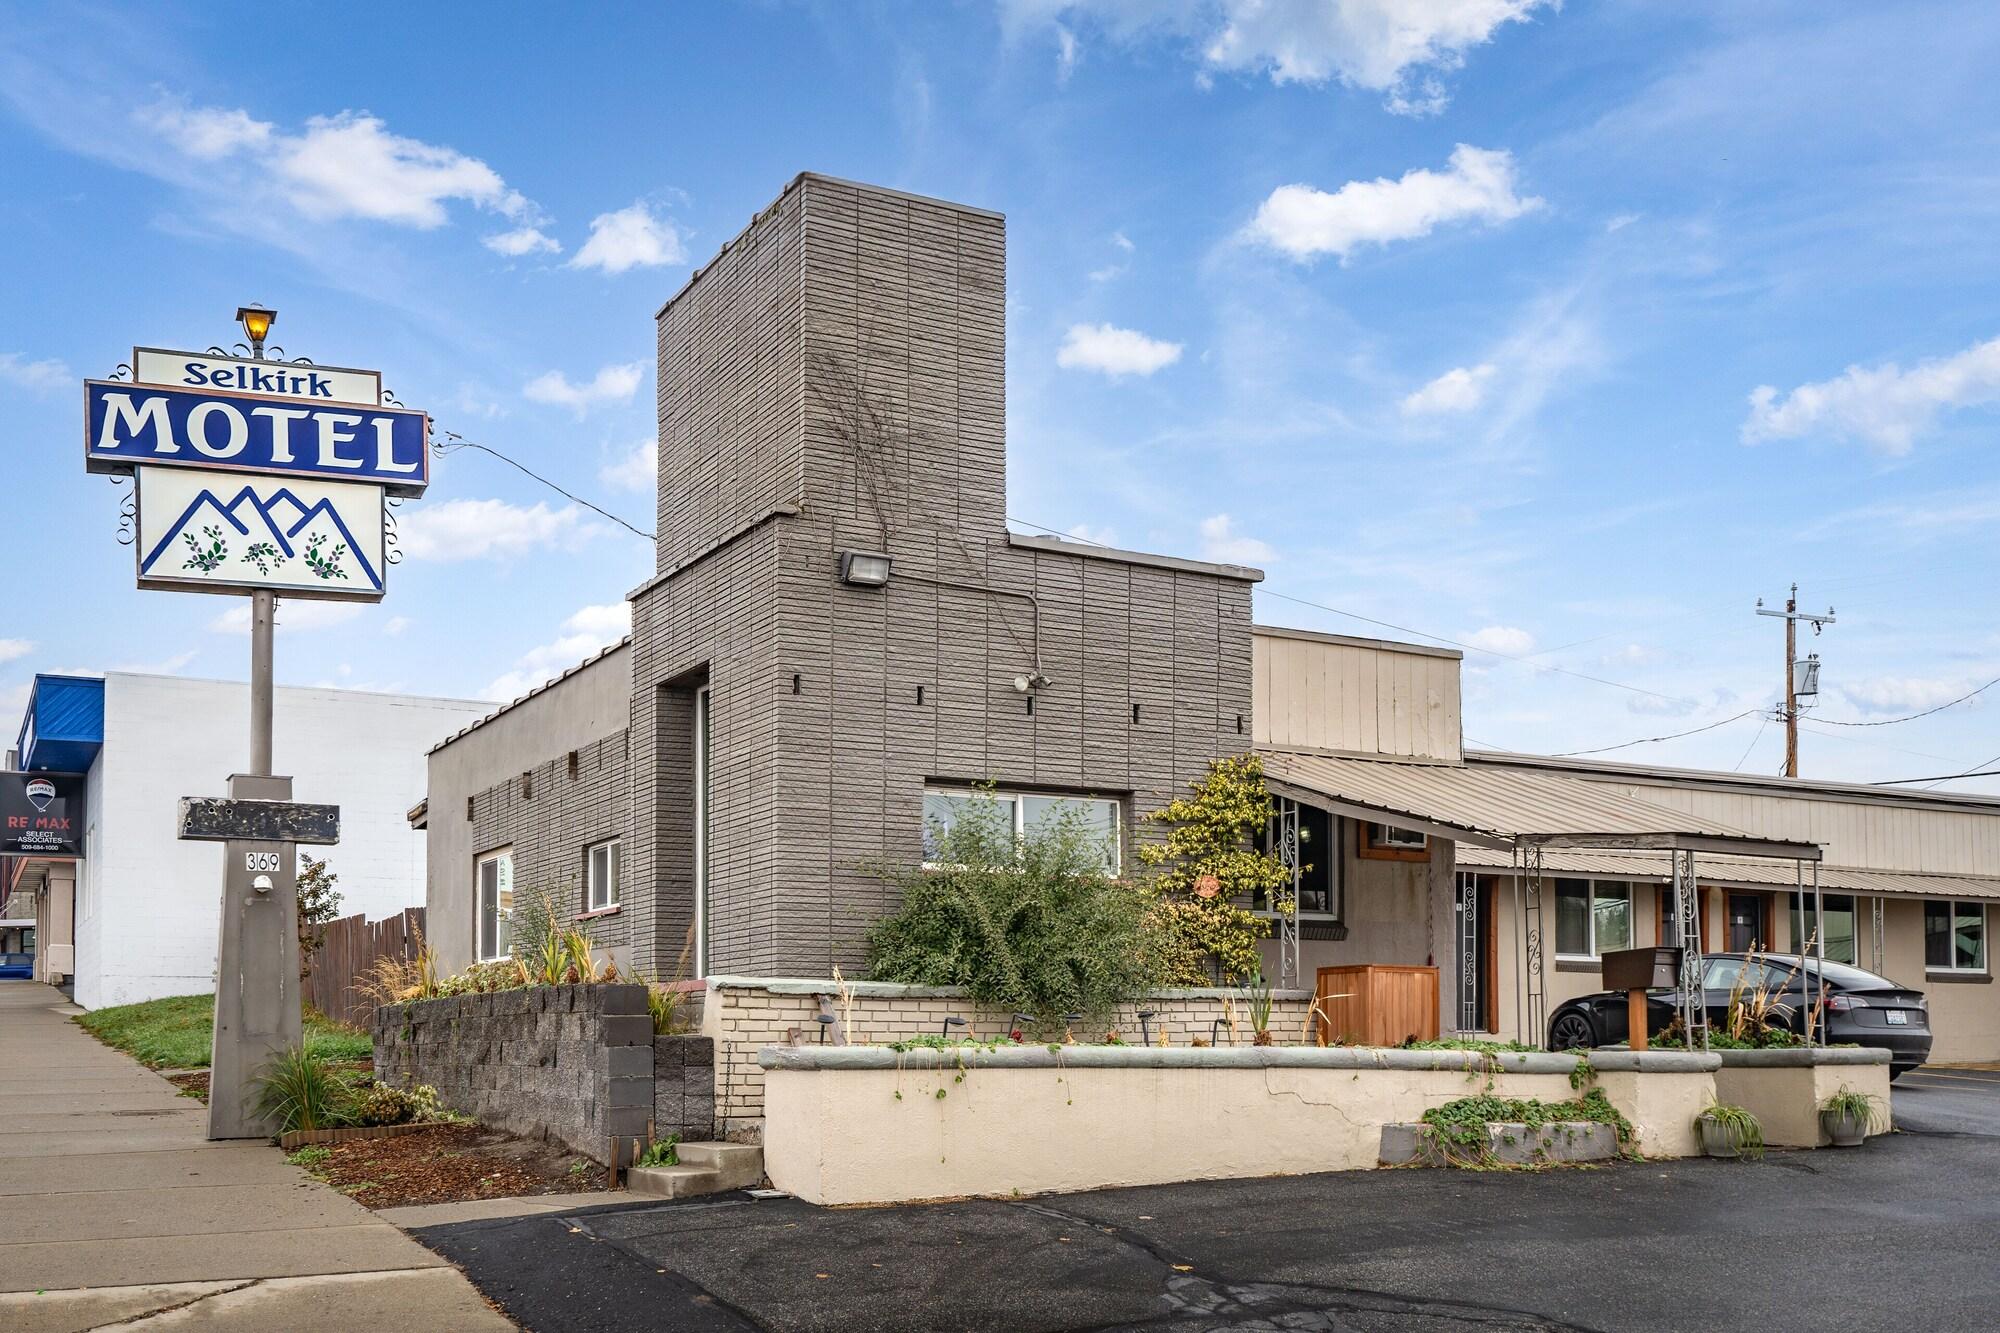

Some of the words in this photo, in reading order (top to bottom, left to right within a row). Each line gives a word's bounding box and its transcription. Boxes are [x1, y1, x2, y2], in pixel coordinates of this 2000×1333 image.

[183, 362, 333, 398] Selkirk
[97, 392, 419, 474] MOTEL
[247, 853, 279, 871] 369
